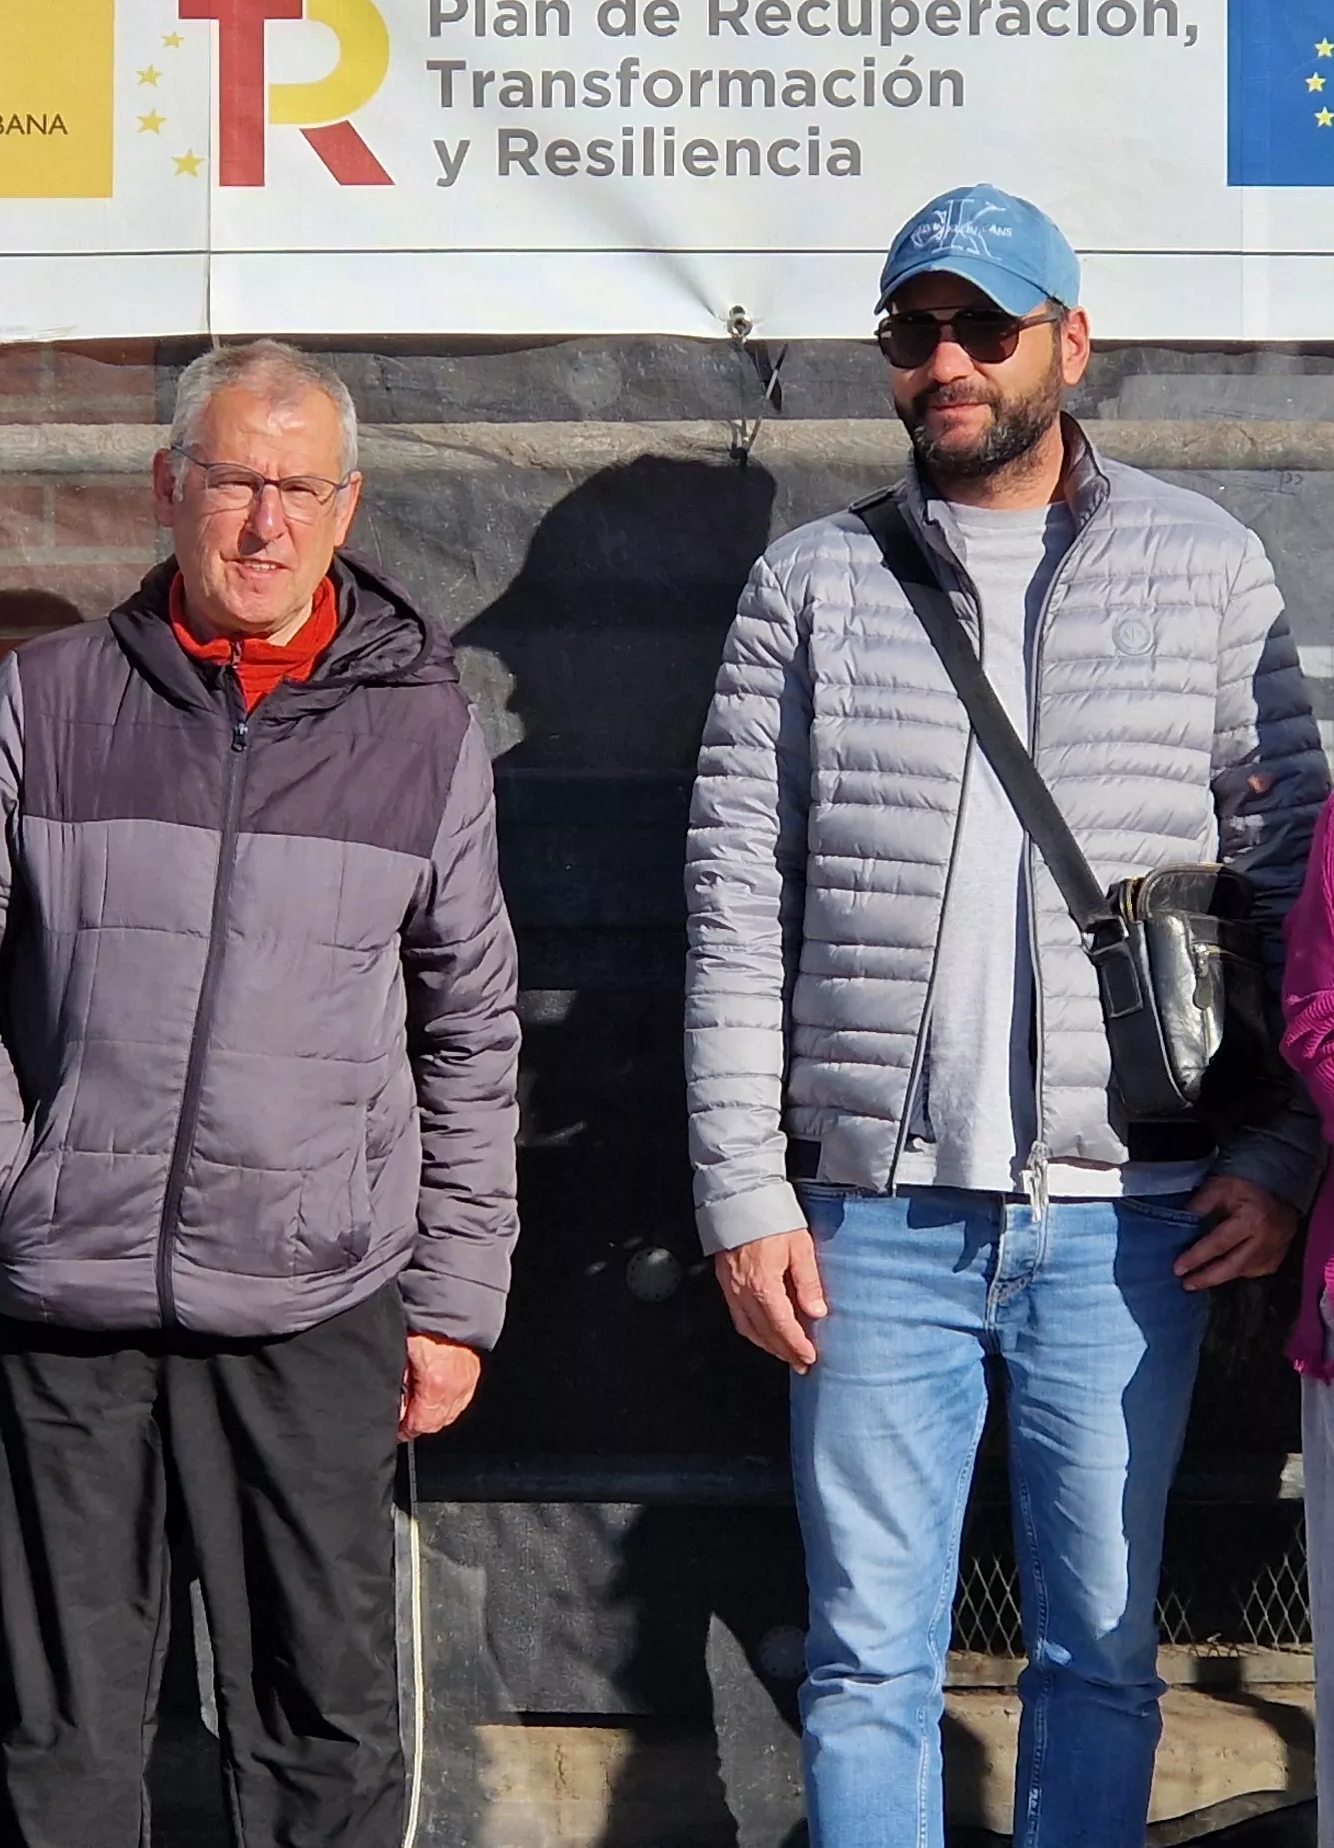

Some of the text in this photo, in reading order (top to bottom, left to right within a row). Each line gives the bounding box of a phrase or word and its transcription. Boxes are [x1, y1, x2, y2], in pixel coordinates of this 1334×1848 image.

[428, 0, 571, 38] Plan
[596, 0, 681, 38] de
[425, 54, 965, 110] Transformación
[433, 125, 862, 187] y Resiliencia
